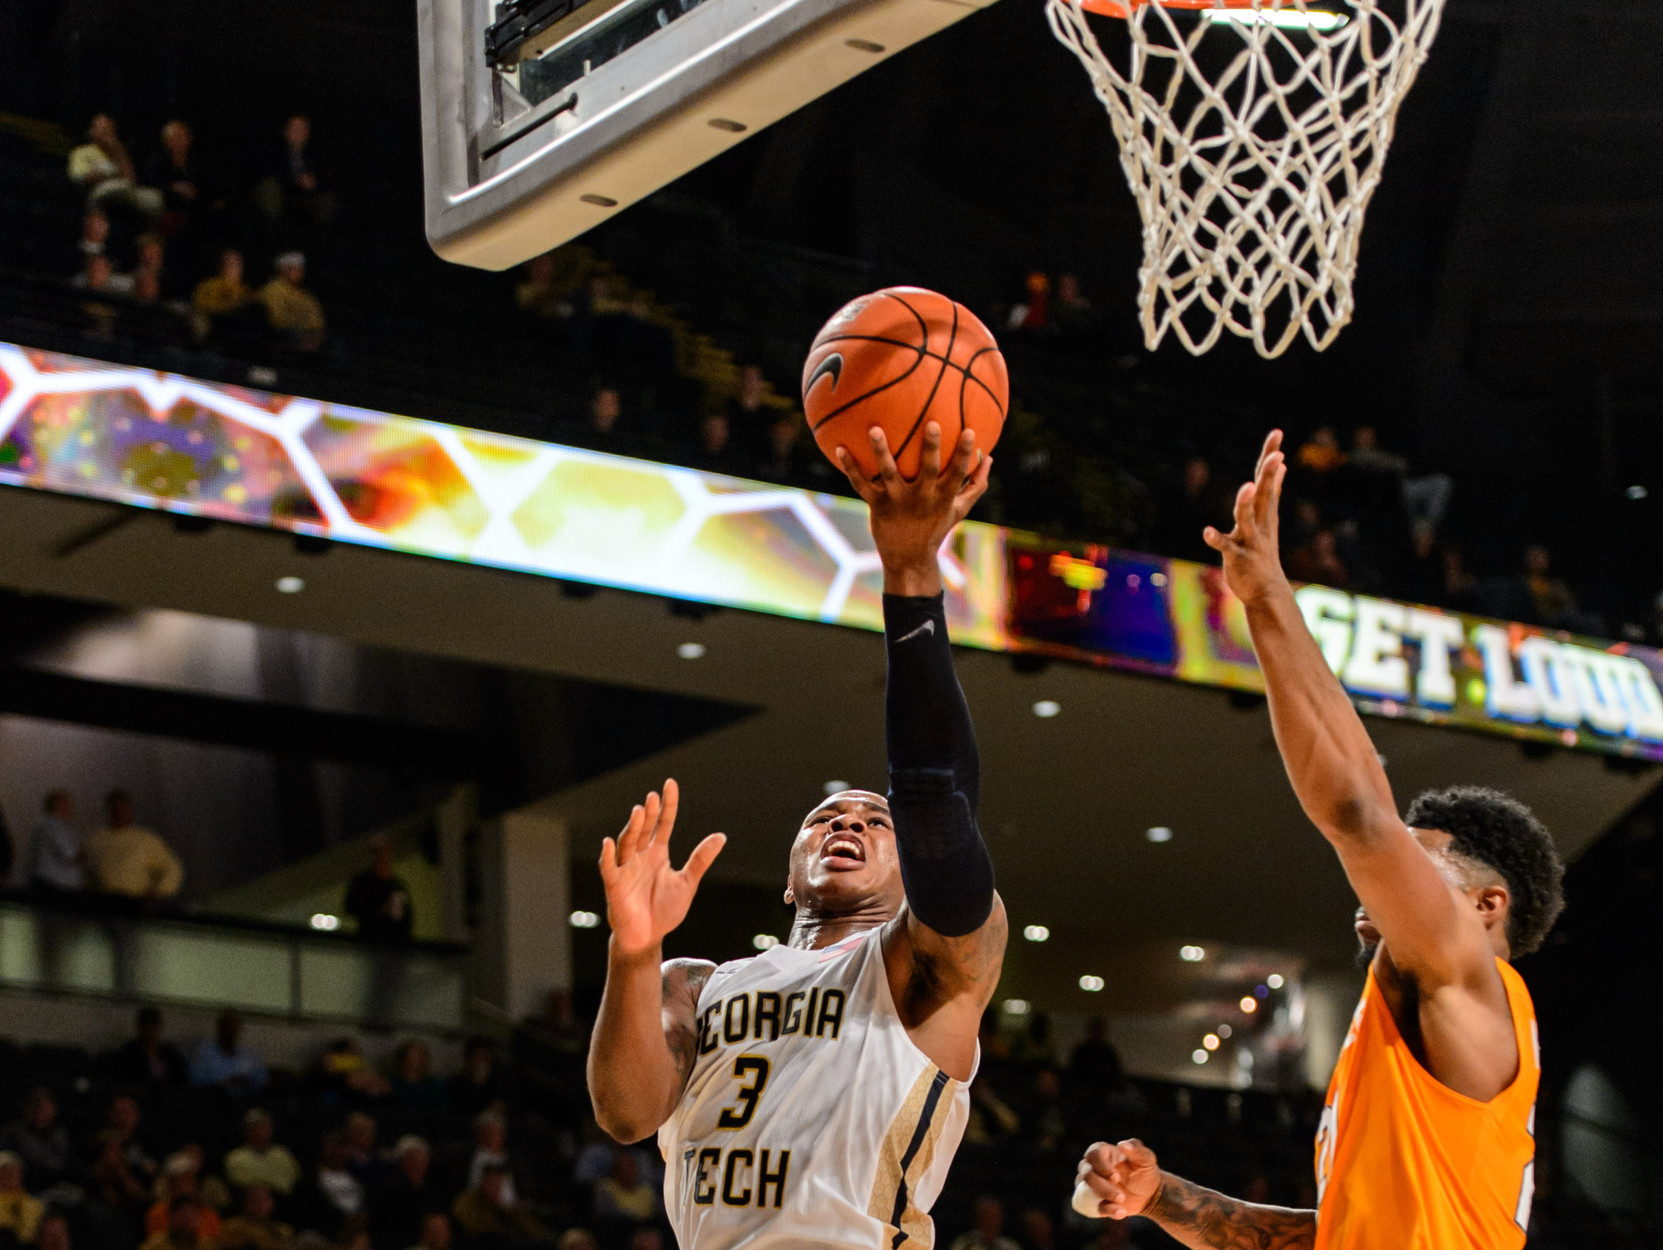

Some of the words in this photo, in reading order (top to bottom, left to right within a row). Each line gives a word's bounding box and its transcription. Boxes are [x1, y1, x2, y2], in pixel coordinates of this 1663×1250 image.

[1296, 583, 1463, 709] GET
[1474, 625, 1662, 744] LOUD
[698, 986, 846, 1056] EORGIA
[716, 1053, 772, 1132] 3
[682, 1147, 791, 1209] TECH
